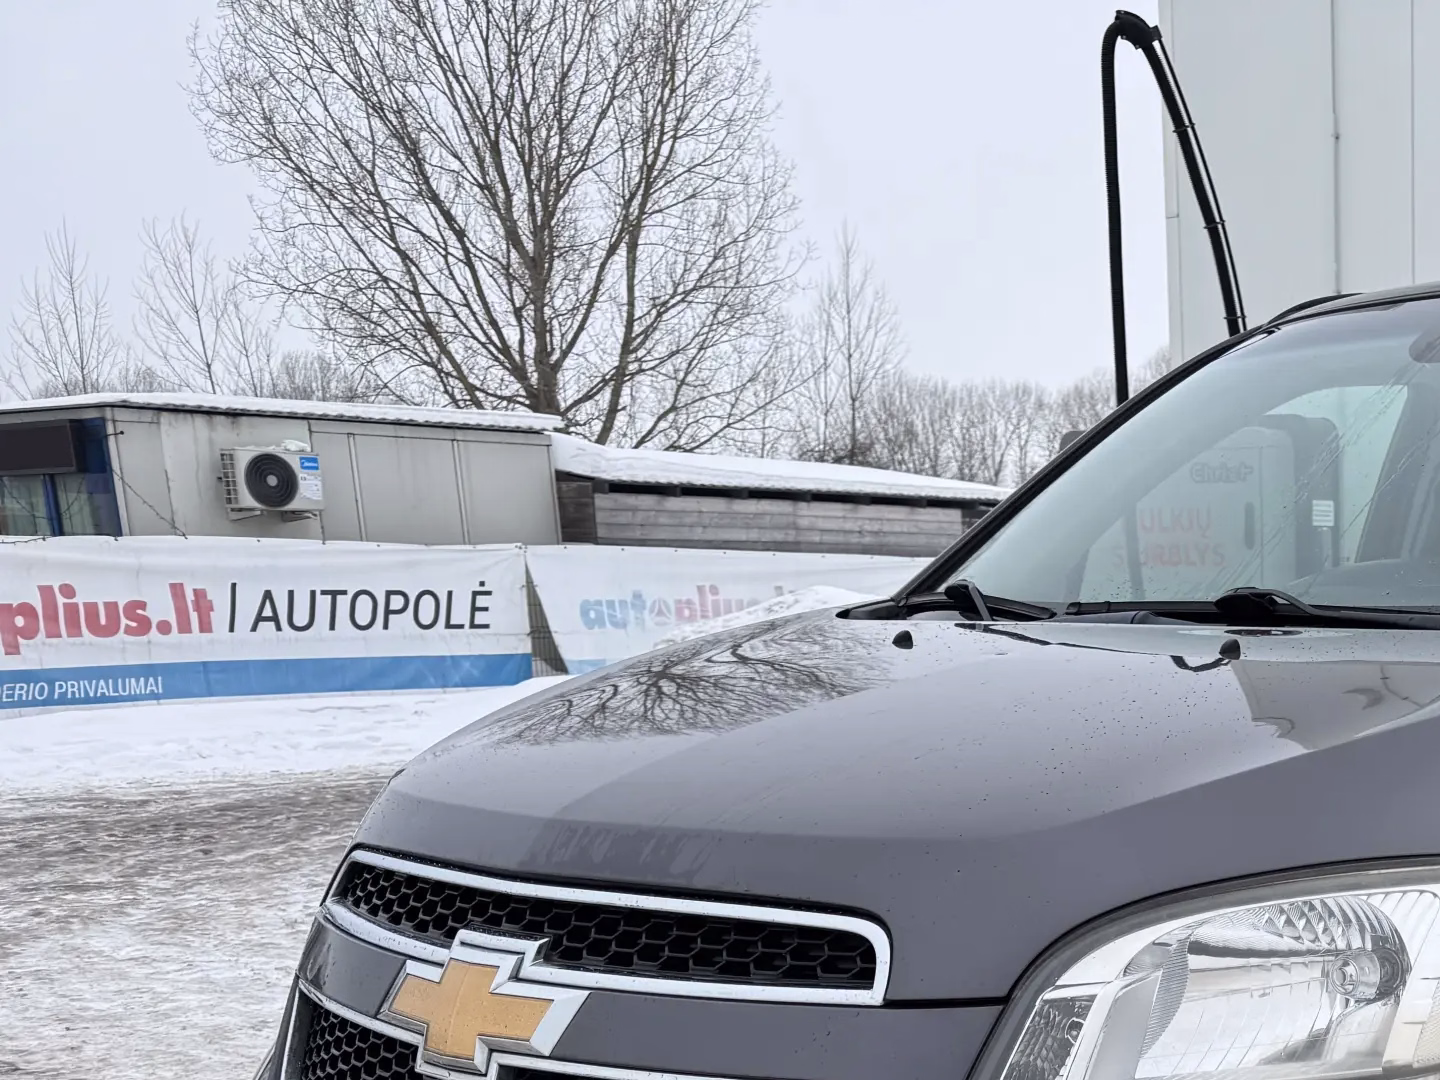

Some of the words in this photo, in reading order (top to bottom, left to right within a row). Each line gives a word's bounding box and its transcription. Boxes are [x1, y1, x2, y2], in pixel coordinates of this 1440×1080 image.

[0, 583, 214, 655] plius.lt
[250, 580, 493, 632] AUTOPOLĖ
[0, 681, 48, 702] ERIO
[54, 676, 163, 700] PRIVALUMAI
